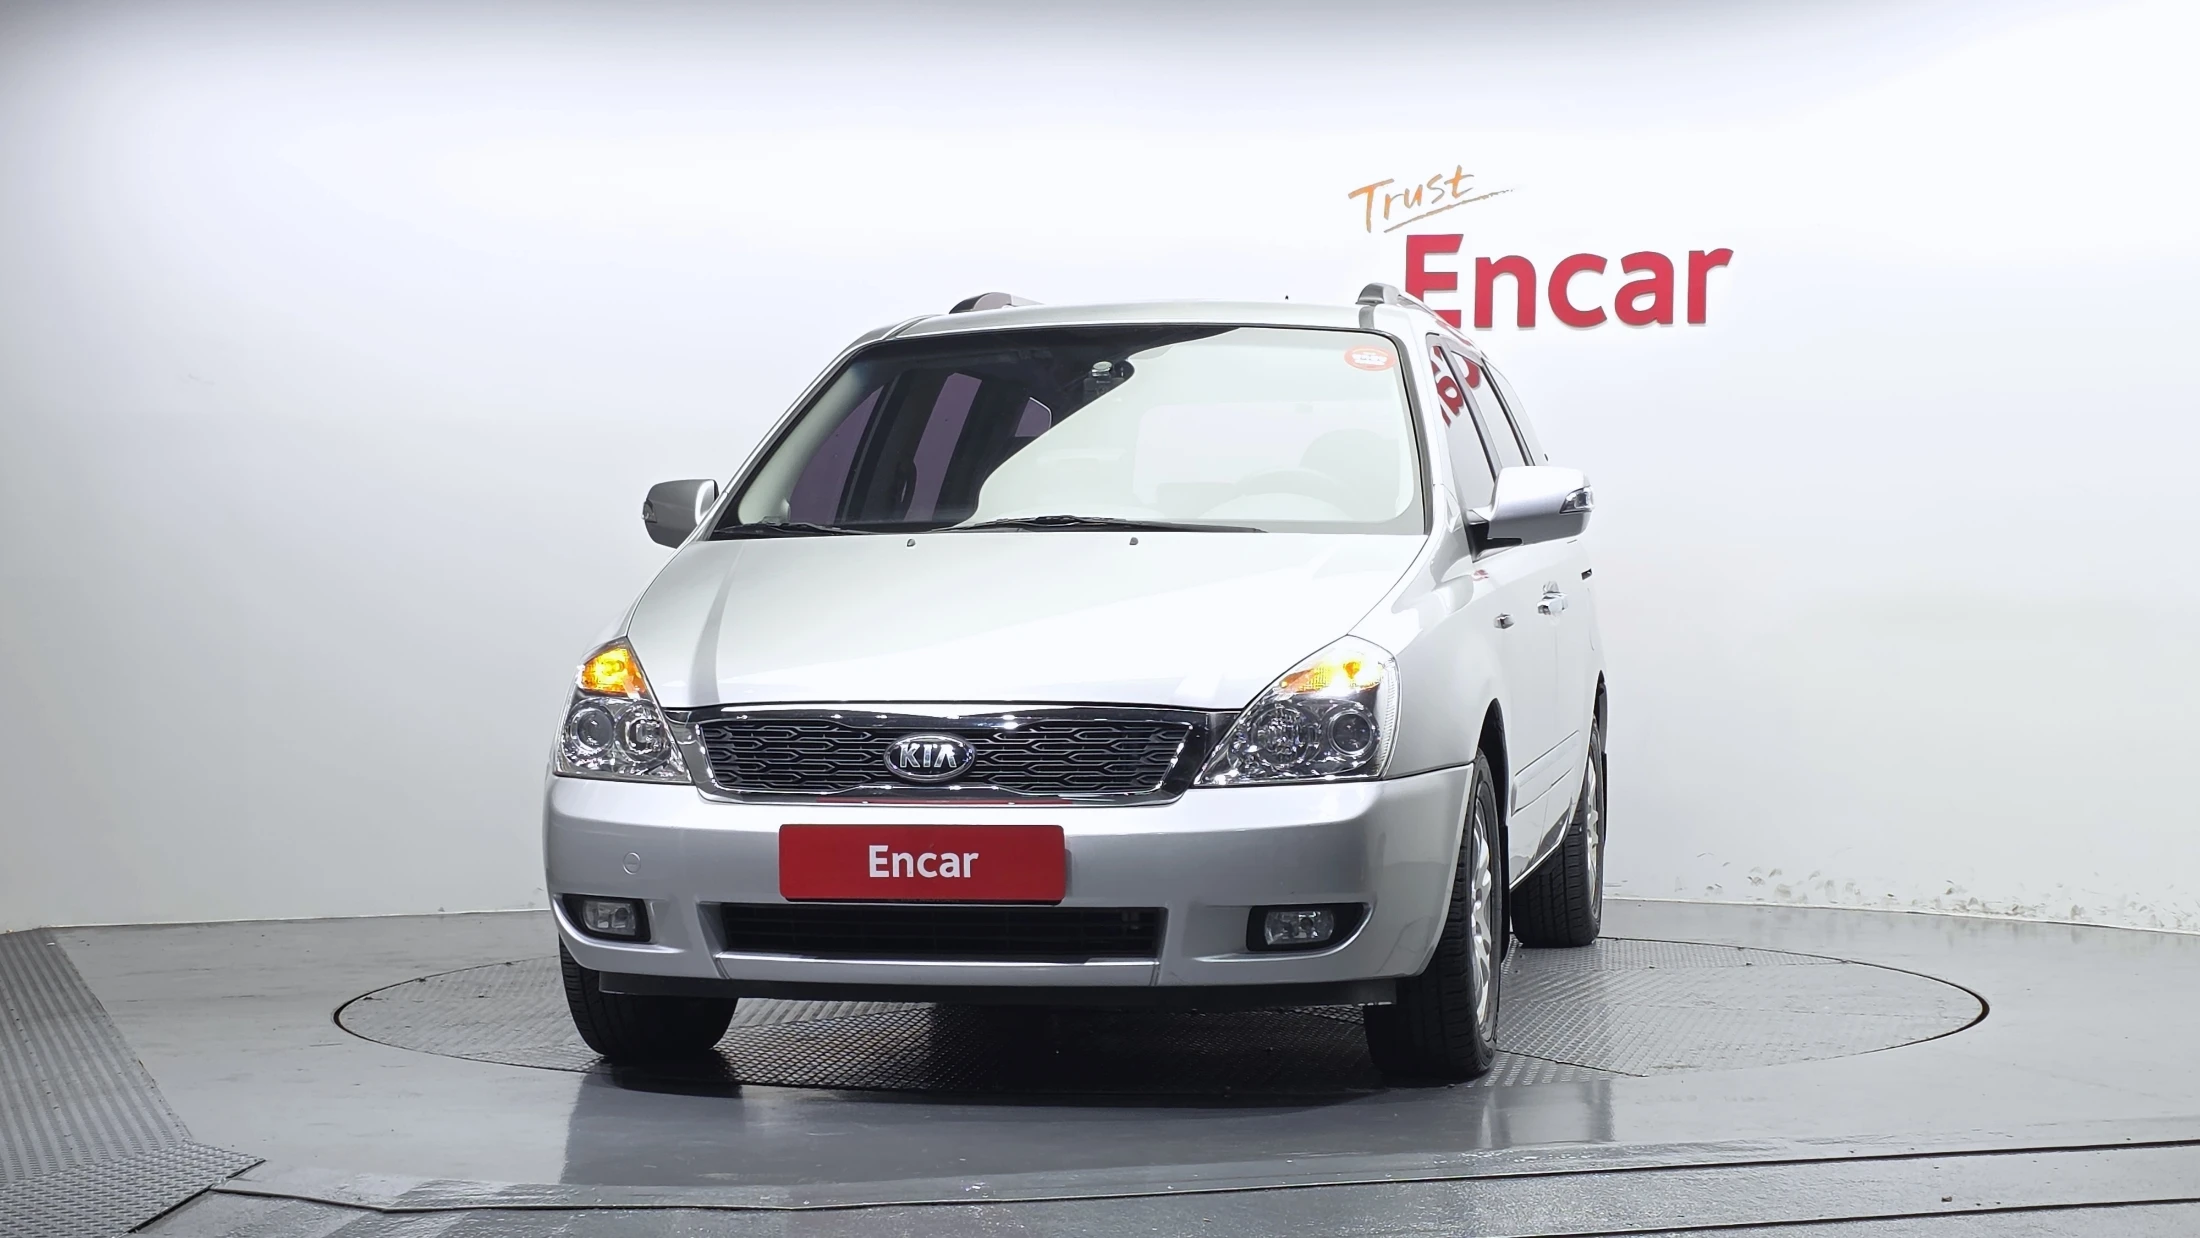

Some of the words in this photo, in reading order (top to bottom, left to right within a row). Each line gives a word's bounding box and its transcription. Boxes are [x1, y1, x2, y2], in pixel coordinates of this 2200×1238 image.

[1348, 165, 1475, 233] Trust
[1405, 234, 1733, 328] Encar
[899, 743, 957, 768] KIA
[869, 845, 979, 878] Encar
